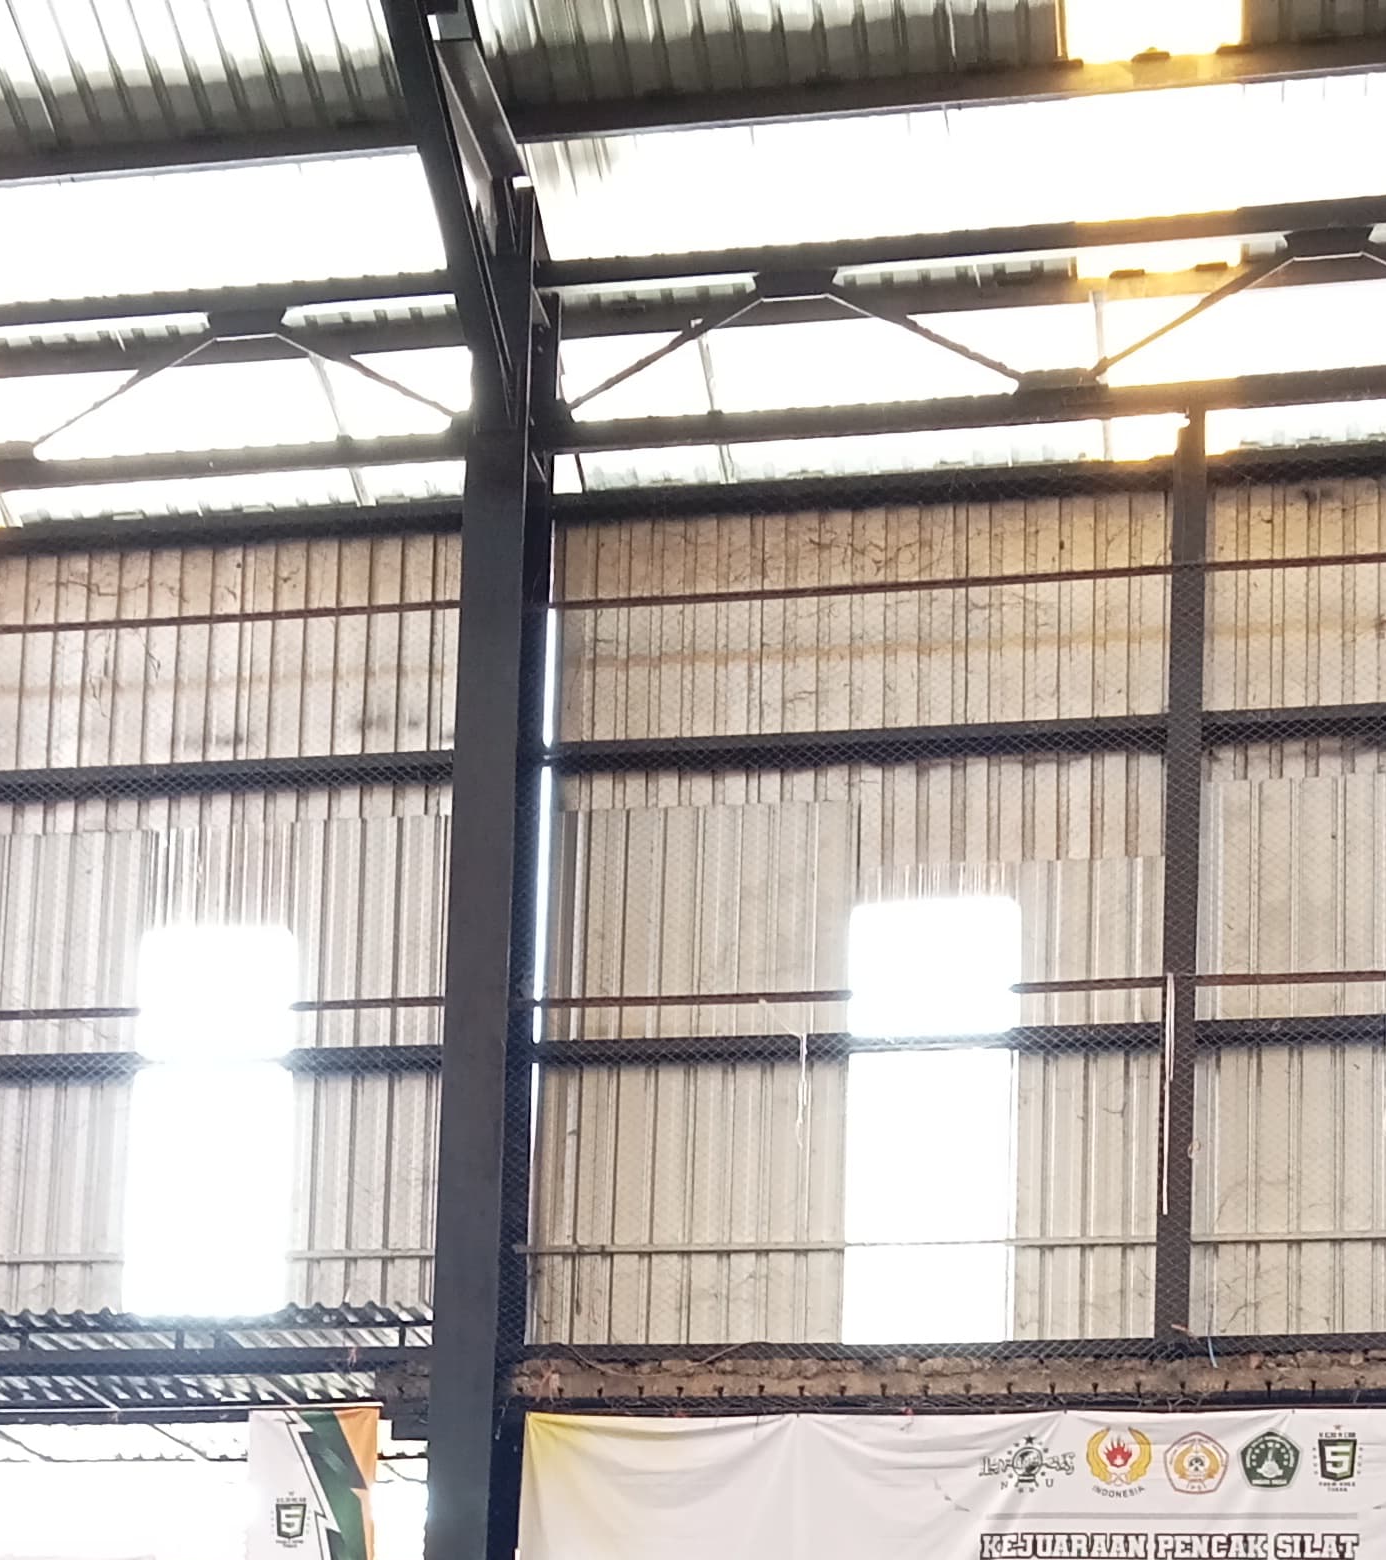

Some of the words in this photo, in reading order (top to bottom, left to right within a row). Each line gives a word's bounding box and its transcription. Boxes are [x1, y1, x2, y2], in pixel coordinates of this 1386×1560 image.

[1092, 1485, 1145, 1499] INDONESIA
[979, 1532, 1149, 1560] KEJUARAAN
[1154, 1533, 1268, 1560] PENCAK
